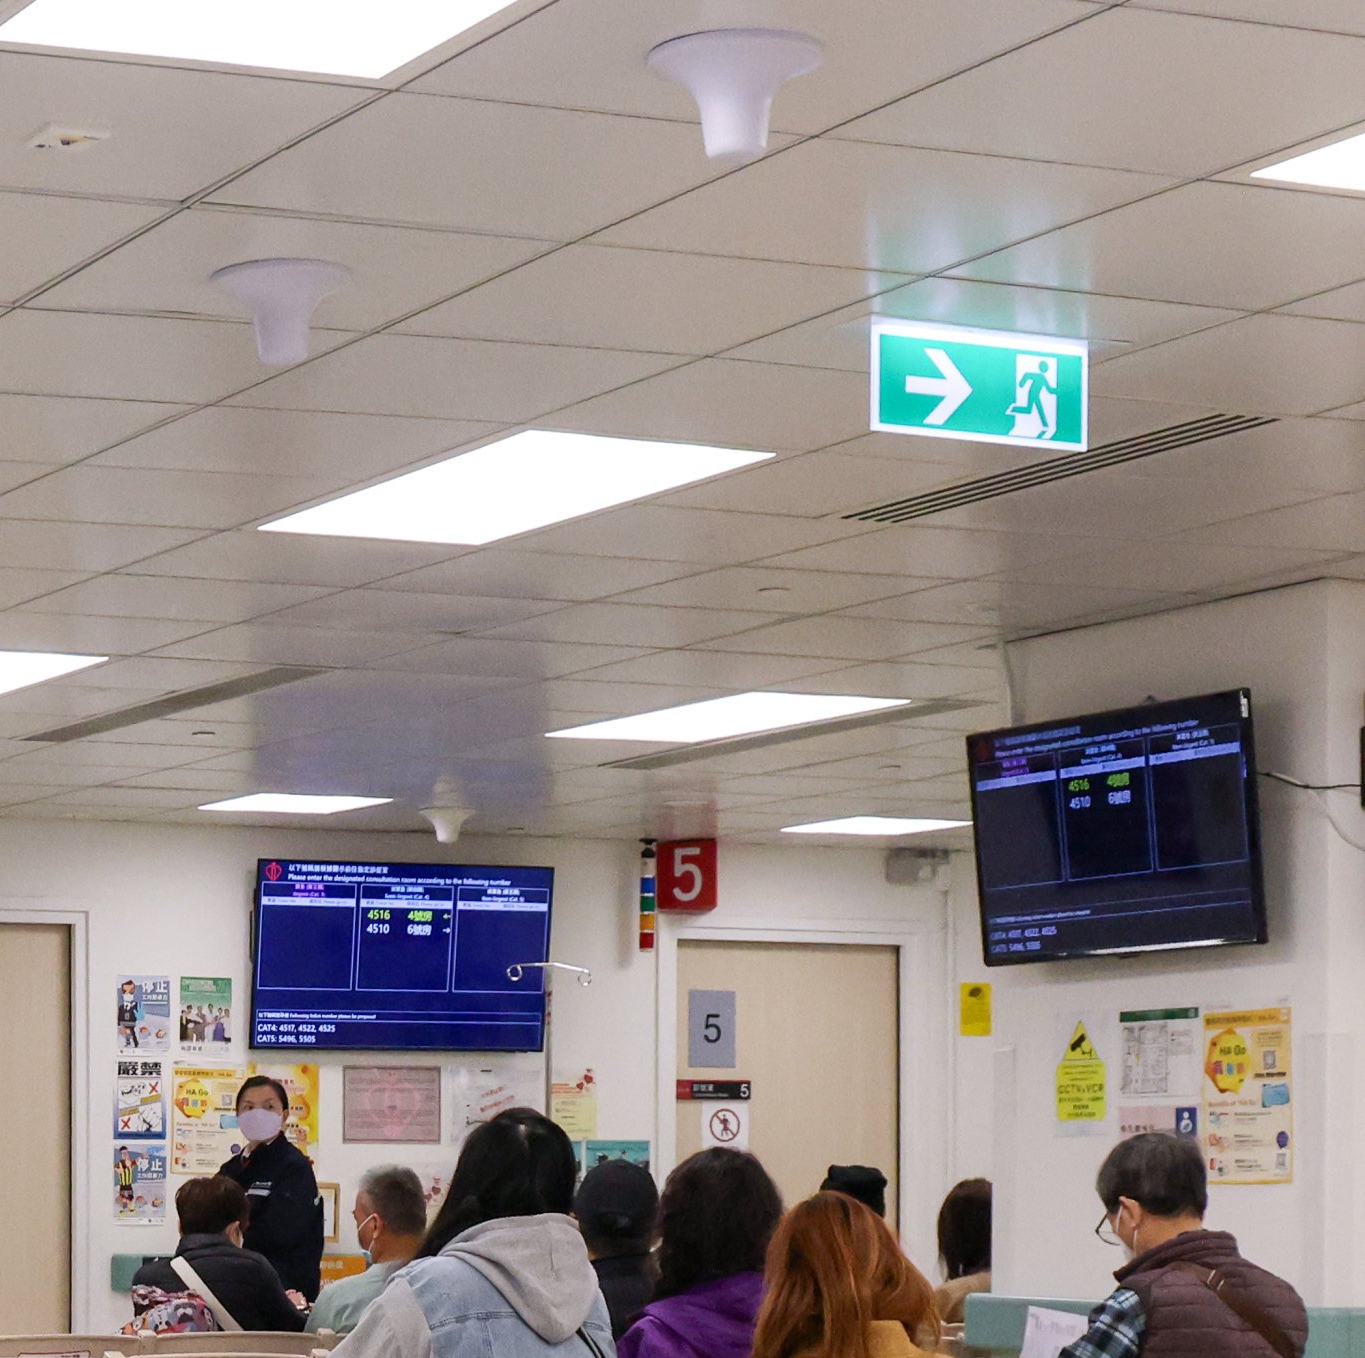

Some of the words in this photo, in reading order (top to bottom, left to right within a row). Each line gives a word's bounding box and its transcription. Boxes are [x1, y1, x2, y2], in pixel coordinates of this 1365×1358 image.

[287, 873, 306, 881] Please
[334, 875, 365, 883] designated
[672, 847, 702, 901] 5
[367, 910, 391, 920] 4516
[366, 924, 390, 934] 4510
[142, 980, 168, 993] 停止
[257, 1024, 278, 1032] CAT4:
[279, 1024, 297, 1033] 4517,
[298, 1024, 317, 1033] 4522,
[703, 1014, 721, 1043] 5
[257, 1035, 278, 1043] CAT5:
[299, 1035, 316, 1043] 5505
[117, 1061, 162, 1076] 嚴禁
[739, 1083, 749, 1098] 5
[137, 1158, 163, 1172] 停止
